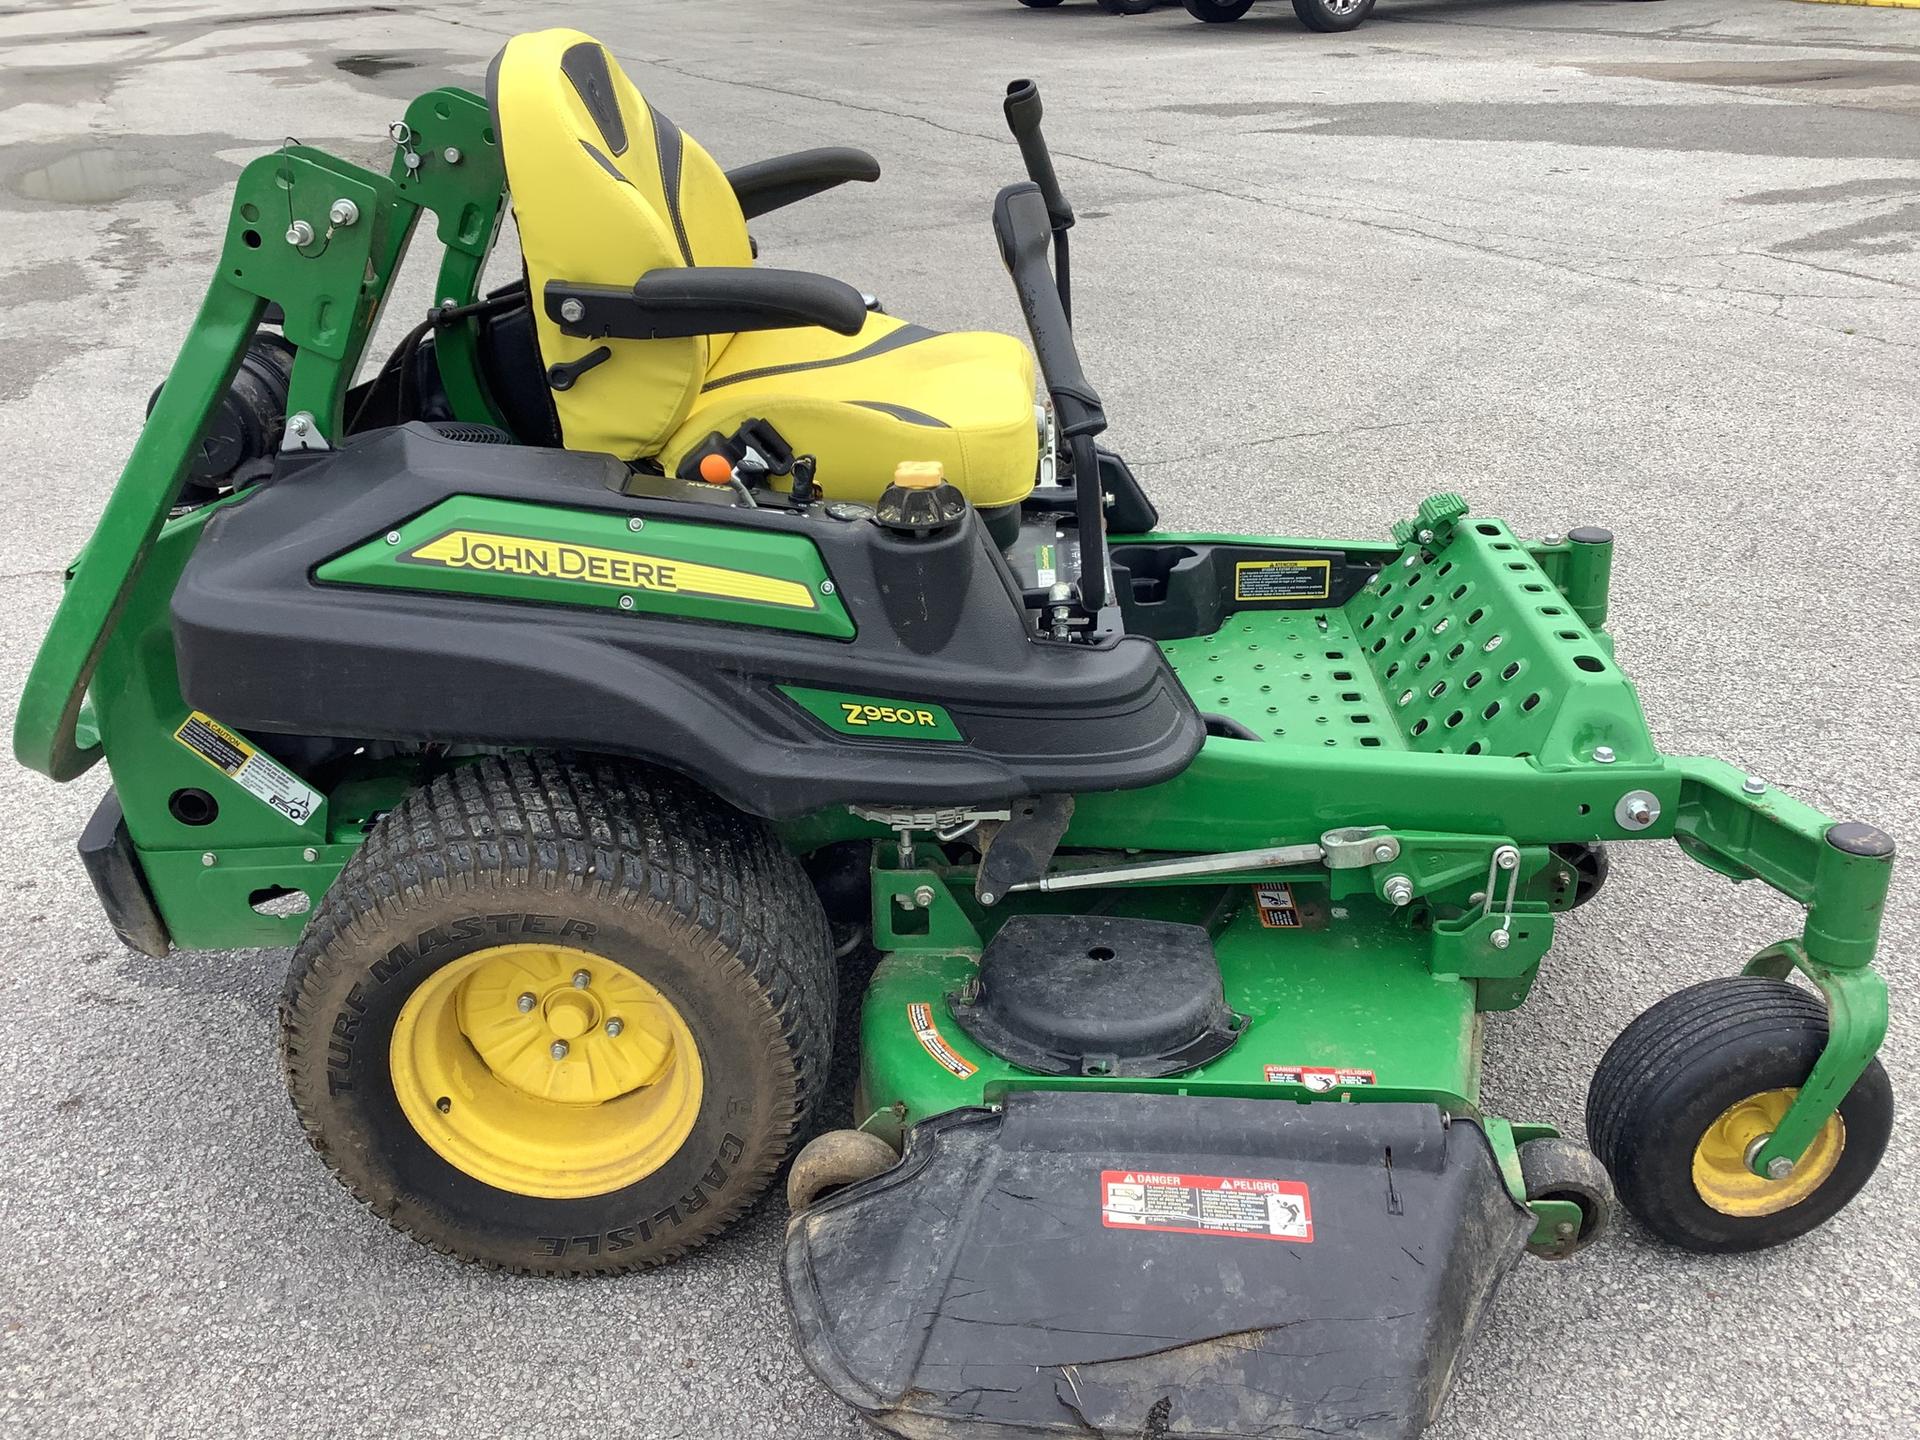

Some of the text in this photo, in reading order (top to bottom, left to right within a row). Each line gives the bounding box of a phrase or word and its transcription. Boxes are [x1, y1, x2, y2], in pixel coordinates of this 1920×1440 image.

[450, 536, 677, 588] JOHN DEERE
[841, 703, 936, 727] Z950R
[210, 724, 241, 747] CAUTION
[327, 912, 600, 1097] TURF MASTER
[1137, 1174, 1181, 1186] DANGER
[1233, 1181, 1280, 1193] PELIGRO
[532, 1132, 745, 1257] CARLISLE
